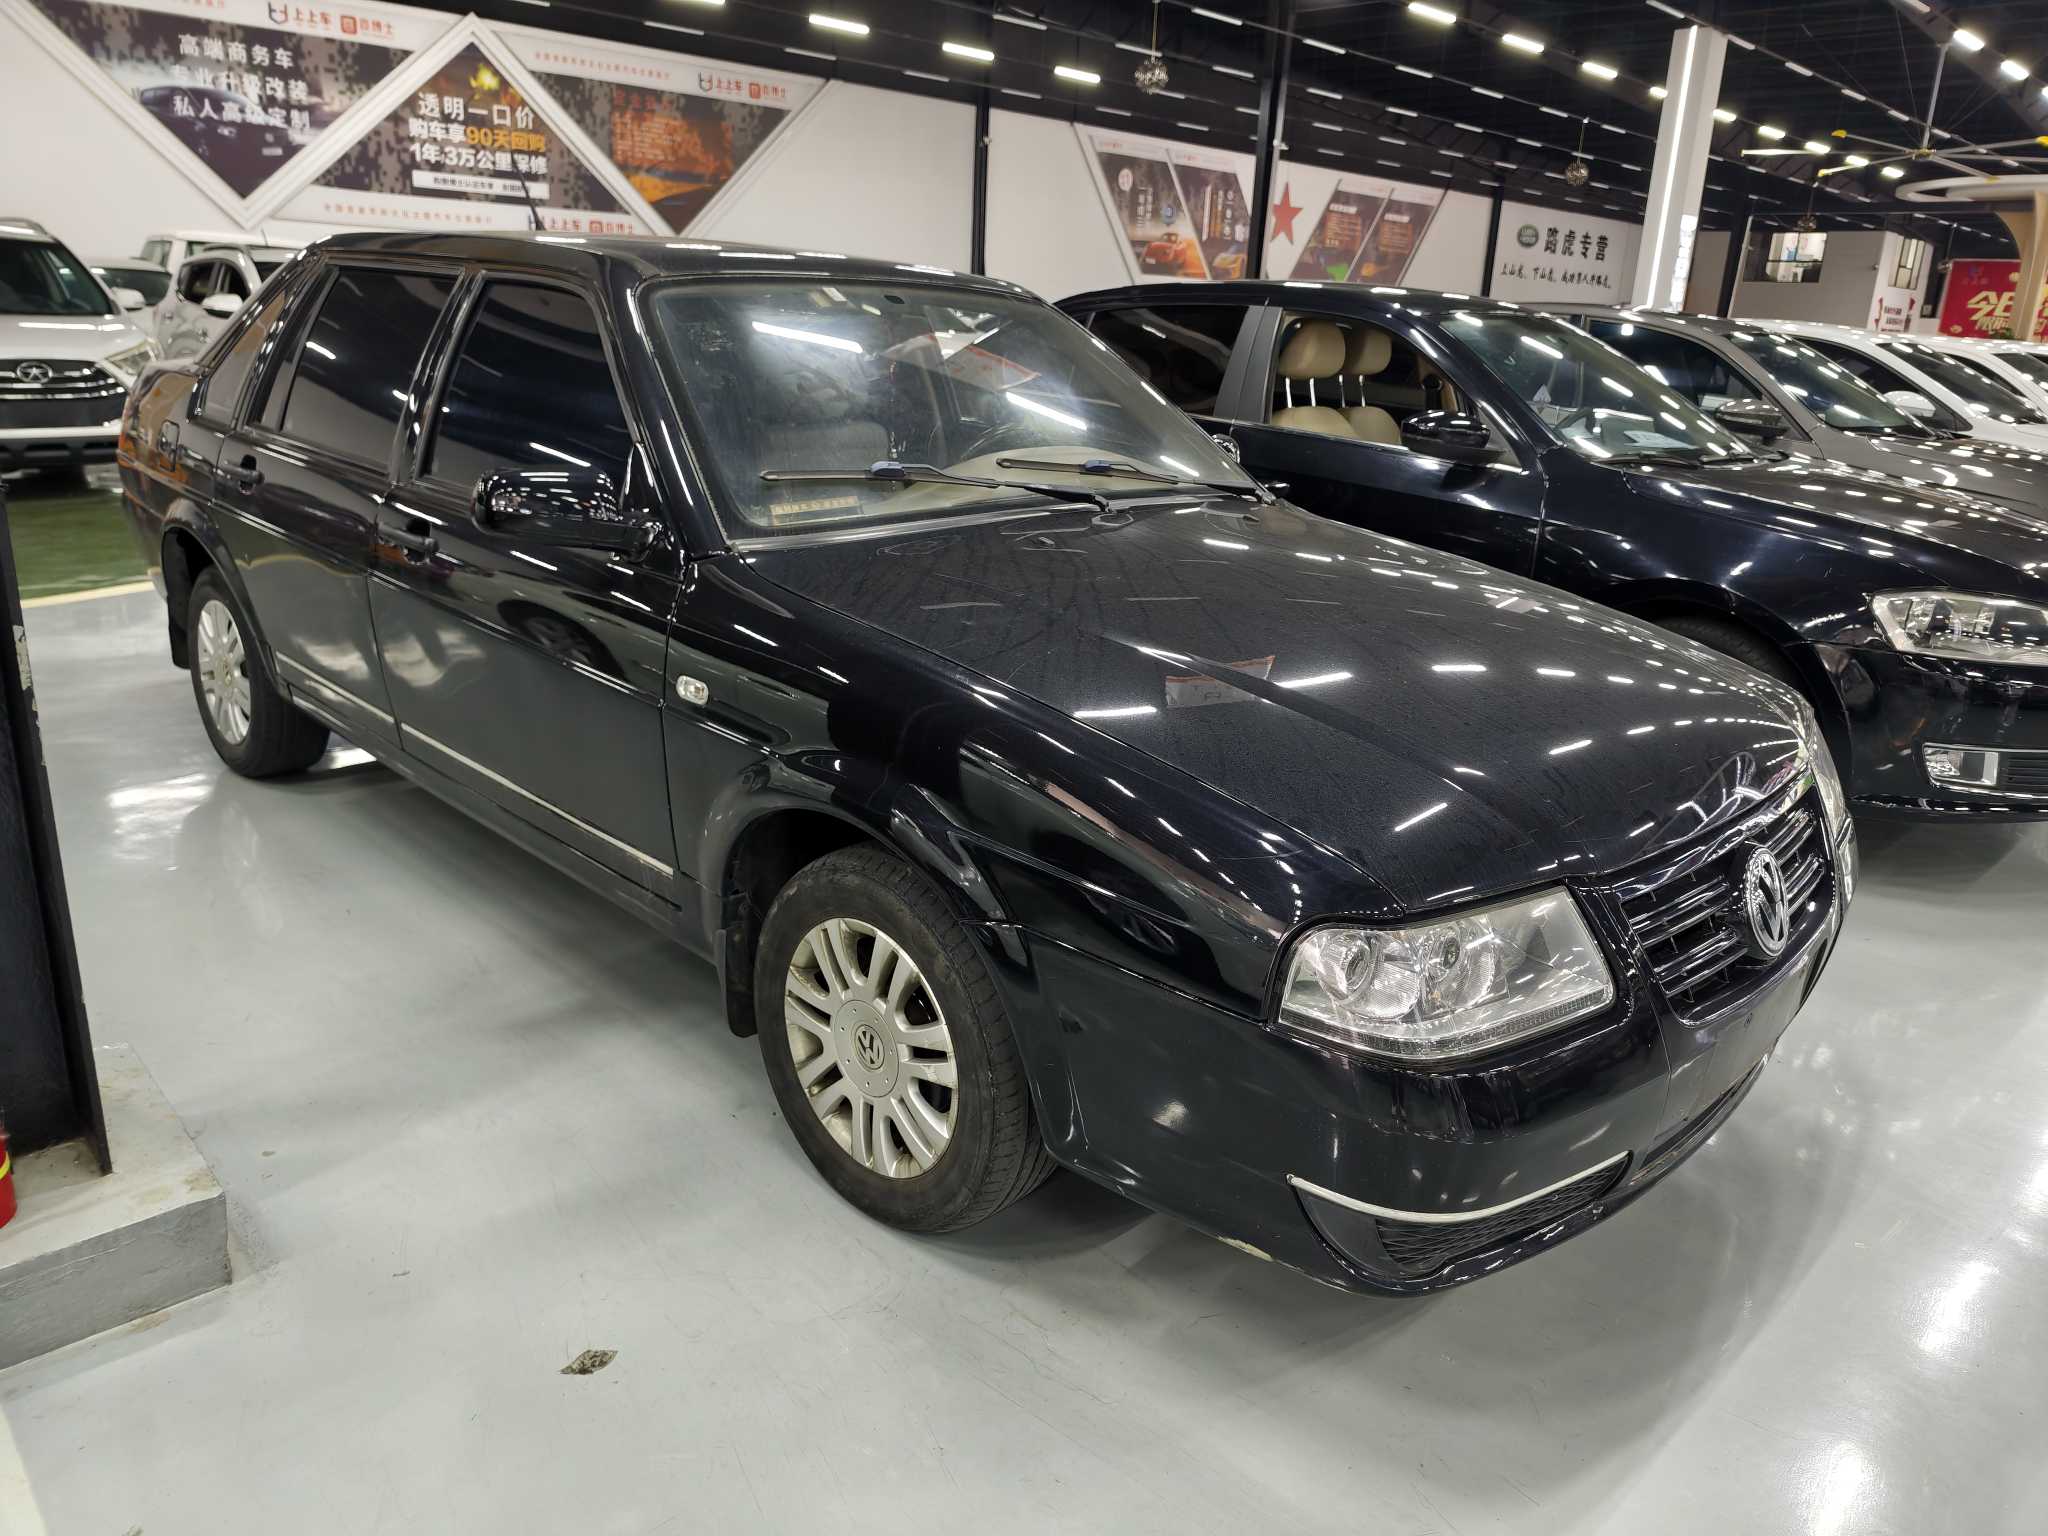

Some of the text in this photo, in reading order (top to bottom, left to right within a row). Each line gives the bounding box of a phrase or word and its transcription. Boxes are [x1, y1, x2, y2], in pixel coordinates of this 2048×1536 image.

[178, 33, 294, 69] 高端商务车
[418, 92, 534, 129] 透明一口价
[408, 117, 546, 152] 购车享90天回购
[1543, 226, 1609, 261] 路虎专营
